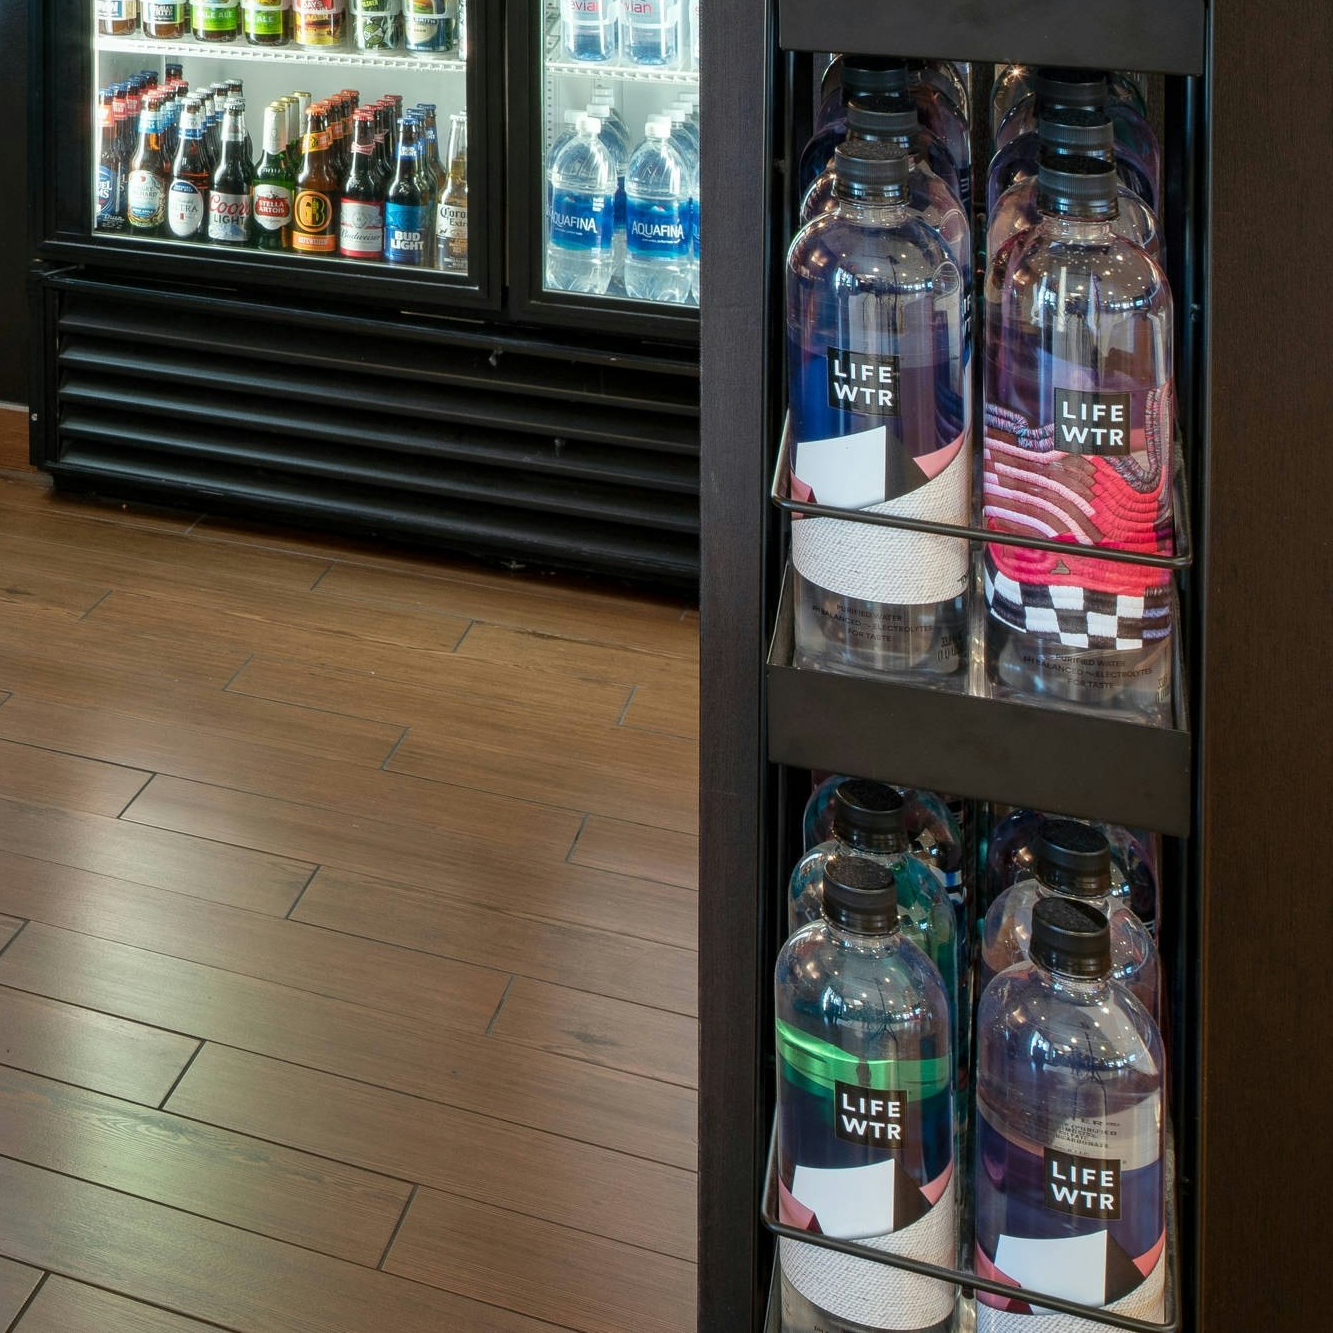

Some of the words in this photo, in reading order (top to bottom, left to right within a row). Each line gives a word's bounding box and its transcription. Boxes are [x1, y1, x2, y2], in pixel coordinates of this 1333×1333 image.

[209, 194, 251, 215] Coors
[440, 207, 467, 219] Coro
[213, 216, 245, 225] LIGHT
[632, 220, 685, 239] AQUAFINA
[341, 230, 381, 241] Budweiser
[391, 241, 424, 250] LIGHT
[395, 231, 420, 242] BUD
[834, 359, 892, 384] LIFE
[833, 383, 893, 407] WTR
[1062, 401, 1124, 422] LIFE
[1061, 425, 1125, 446] WTR
[842, 1093, 901, 1118] LIFE
[841, 1115, 902, 1140] WTR
[1052, 1160, 1114, 1187] LIFE
[1051, 1183, 1114, 1210] WTR
